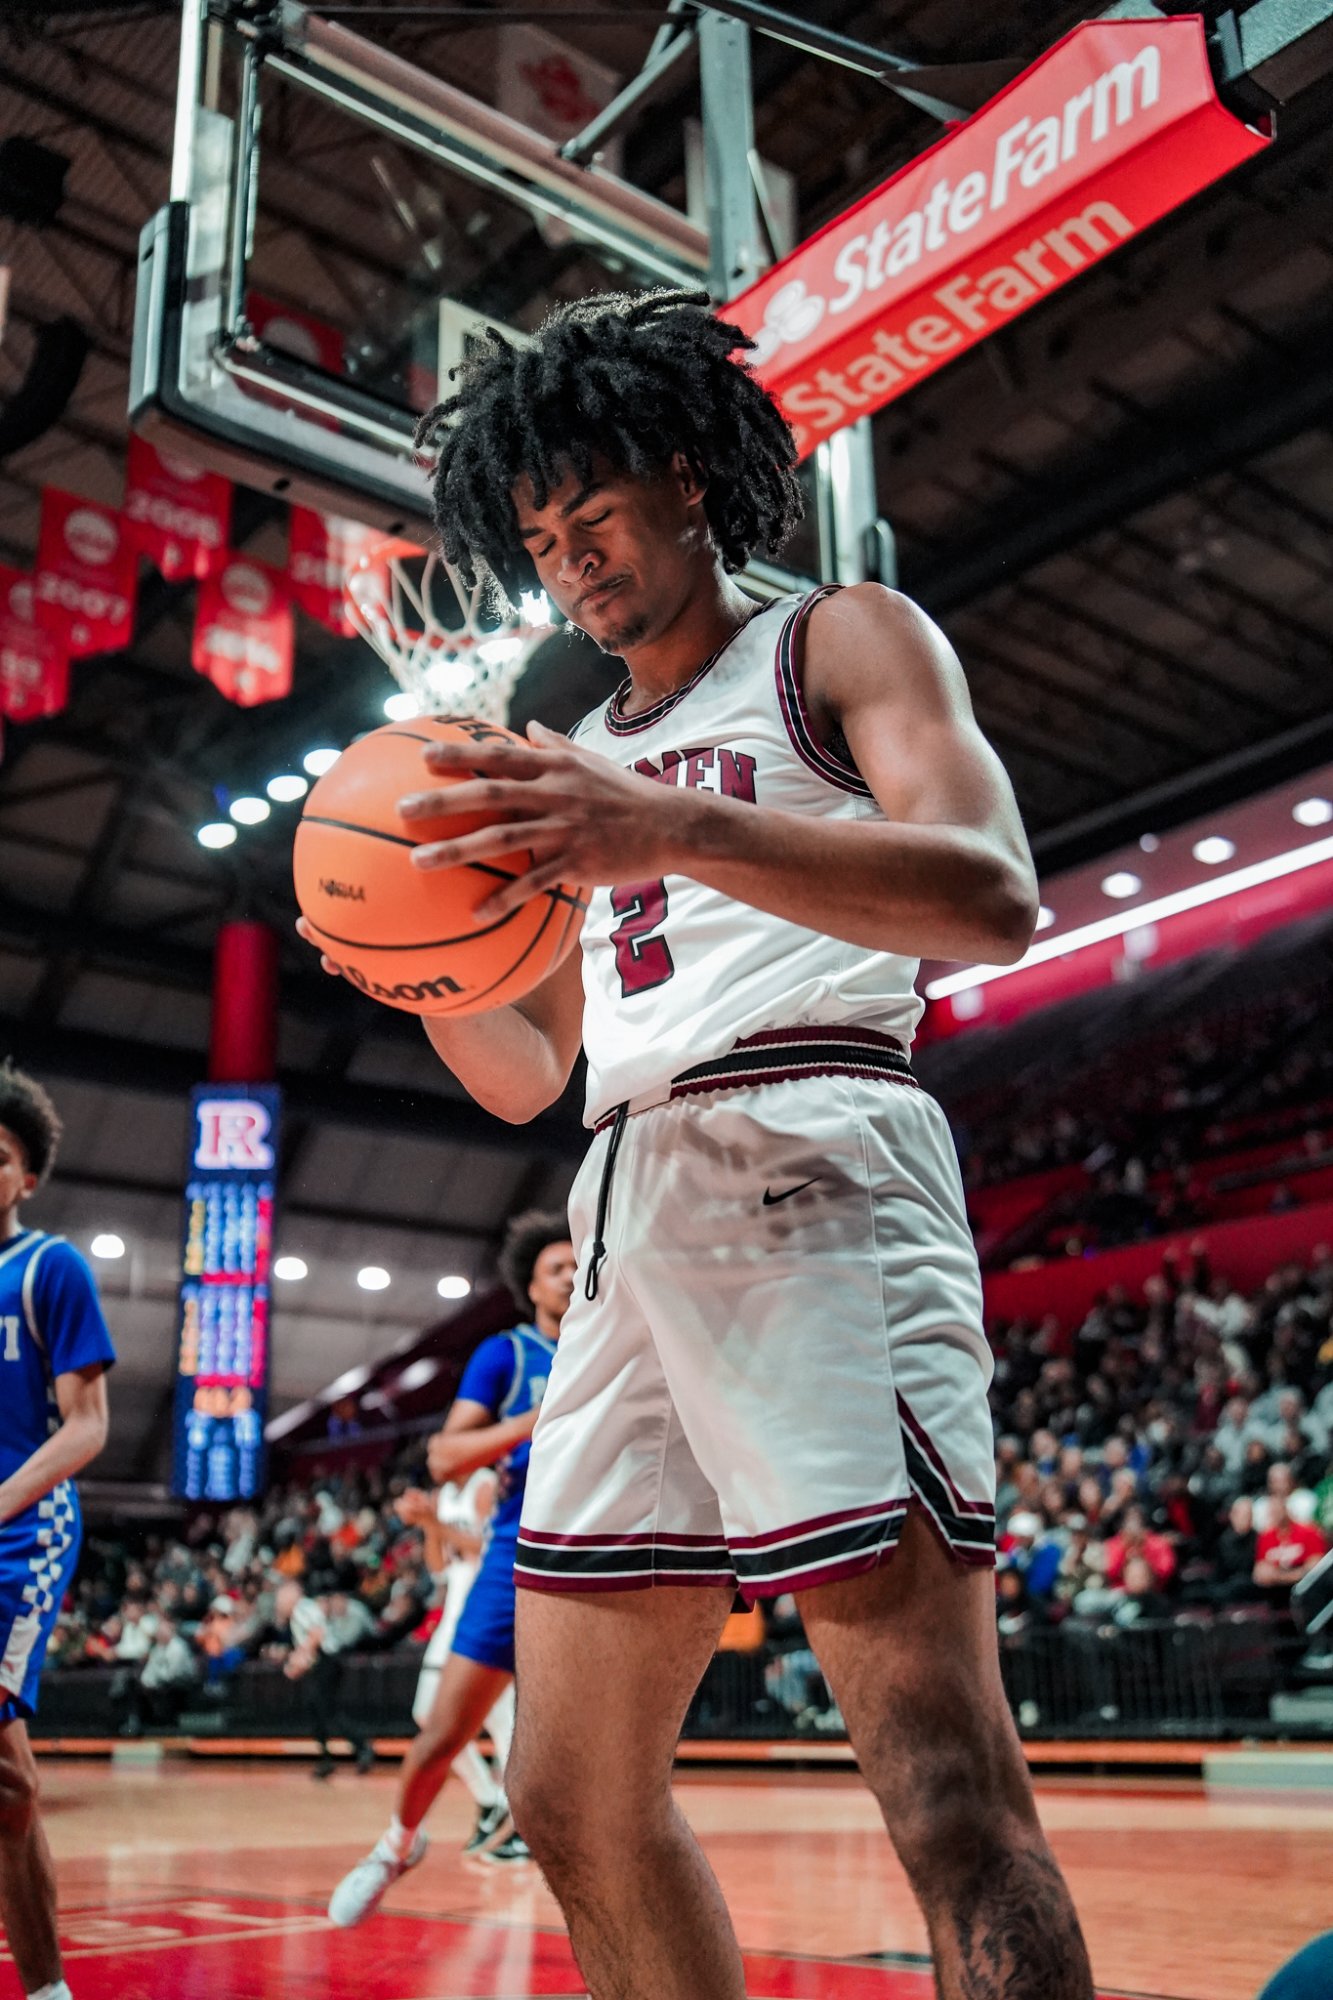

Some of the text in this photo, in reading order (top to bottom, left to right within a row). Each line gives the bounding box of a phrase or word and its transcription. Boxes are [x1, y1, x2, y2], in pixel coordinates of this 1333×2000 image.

[625, 747, 757, 804] MEN
[610, 877, 675, 999] 2
[196, 1100, 273, 1169] R
